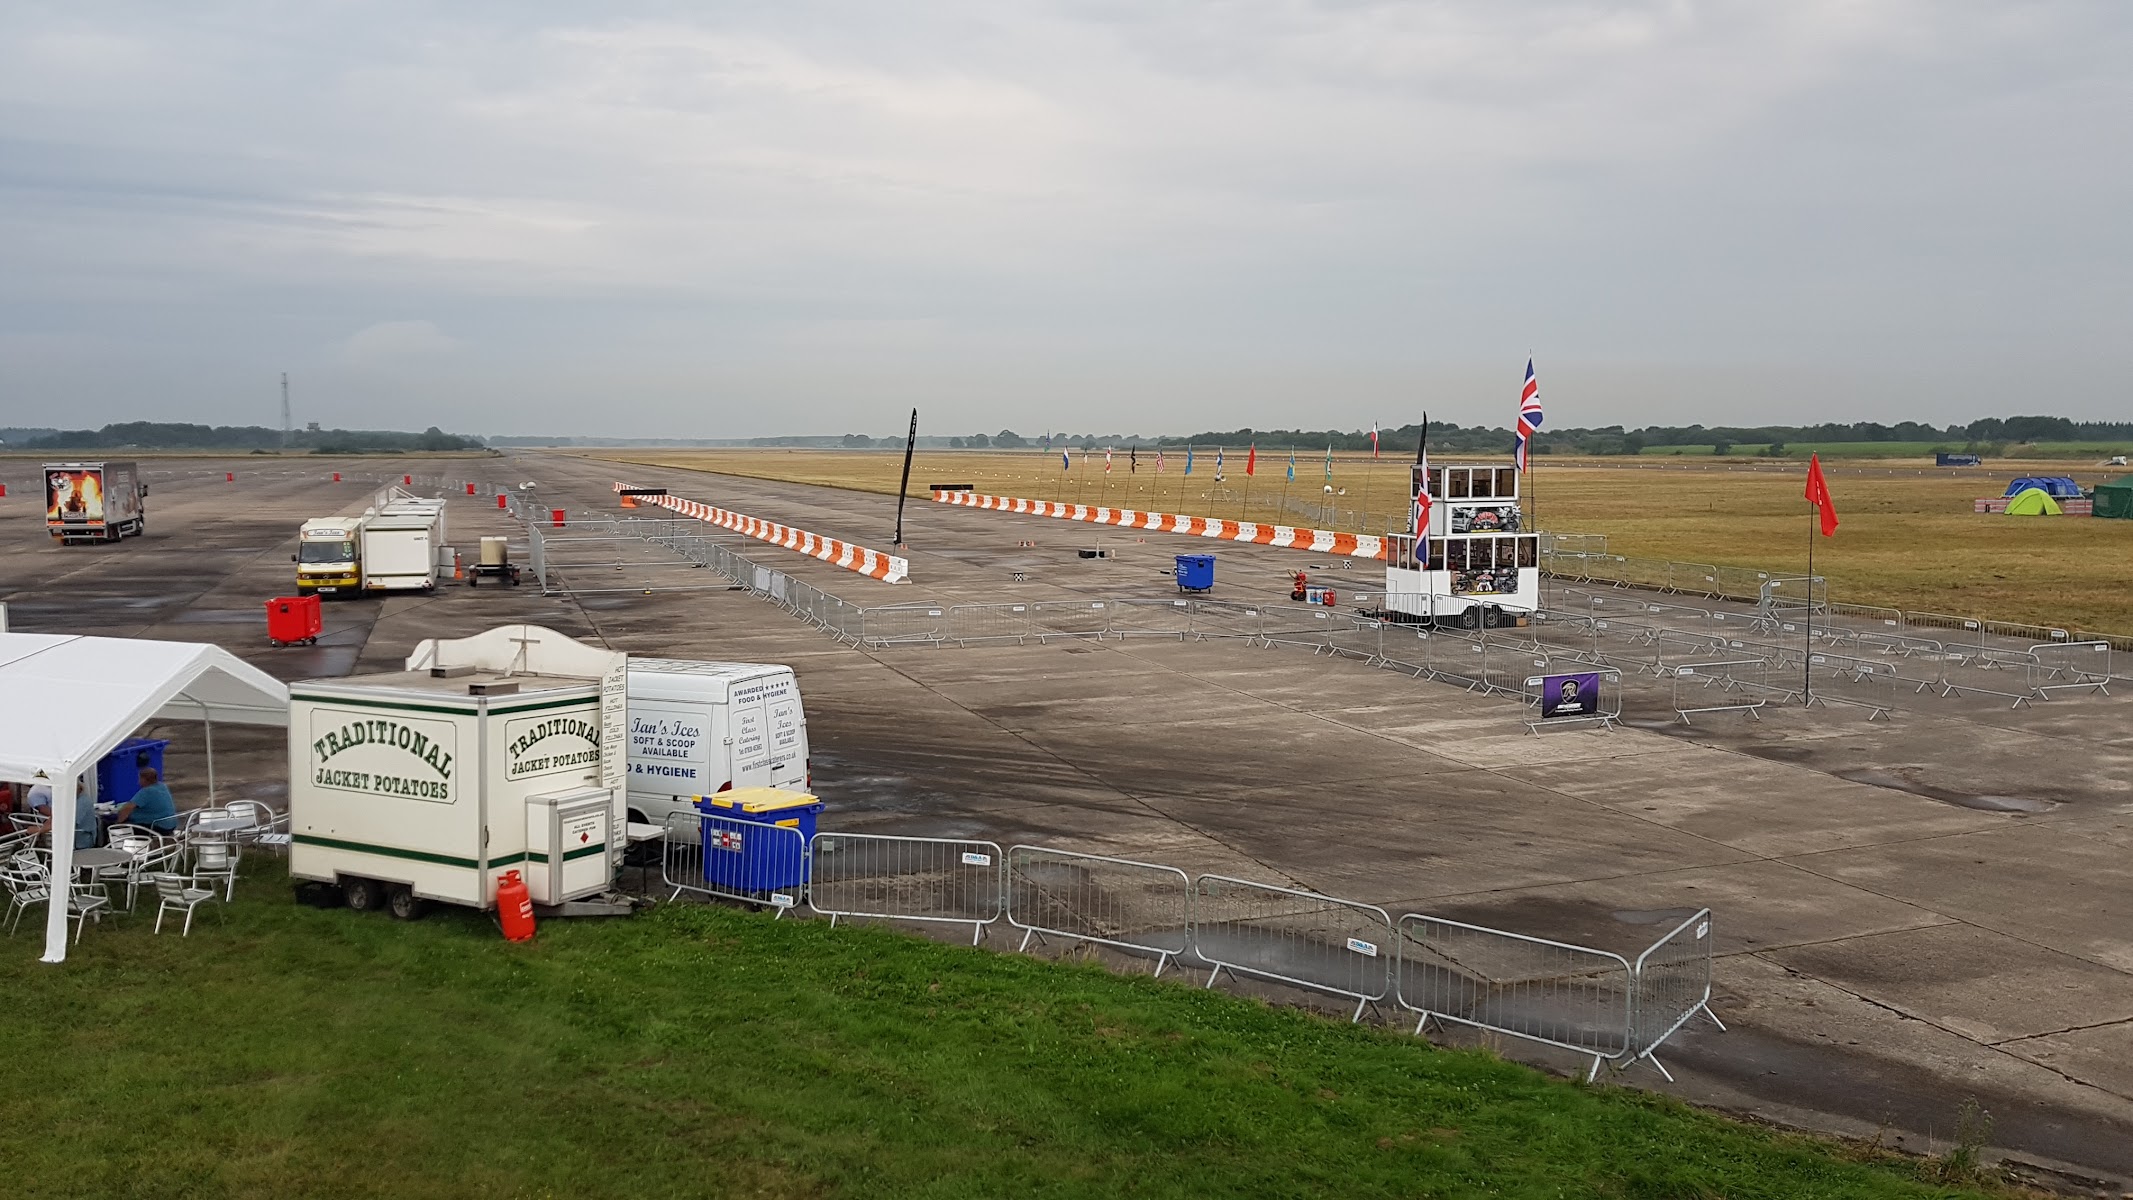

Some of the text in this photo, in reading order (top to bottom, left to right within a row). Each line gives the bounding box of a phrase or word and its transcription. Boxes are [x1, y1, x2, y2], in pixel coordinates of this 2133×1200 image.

[615, 665, 625, 674] HOT
[734, 685, 763, 697] AWARDED
[738, 695, 755, 704] FOOD
[763, 688, 787, 699] HYGIENE
[773, 706, 793, 719] Ian's
[631, 717, 700, 737] Ian's Ices
[741, 726, 756, 735] Class
[509, 718, 600, 760] TRADITIONAL
[633, 735, 696, 748] SOFT & SCOOP
[738, 735, 760, 745] Catering
[314, 720, 452, 780] TRADITIONAL
[642, 746, 689, 758] AVAILABLE
[511, 749, 600, 775] JACKET POTATOES
[635, 763, 643, 774] &
[647, 764, 697, 779] HYGIENE
[316, 768, 448, 799] JACKET POTATOES
